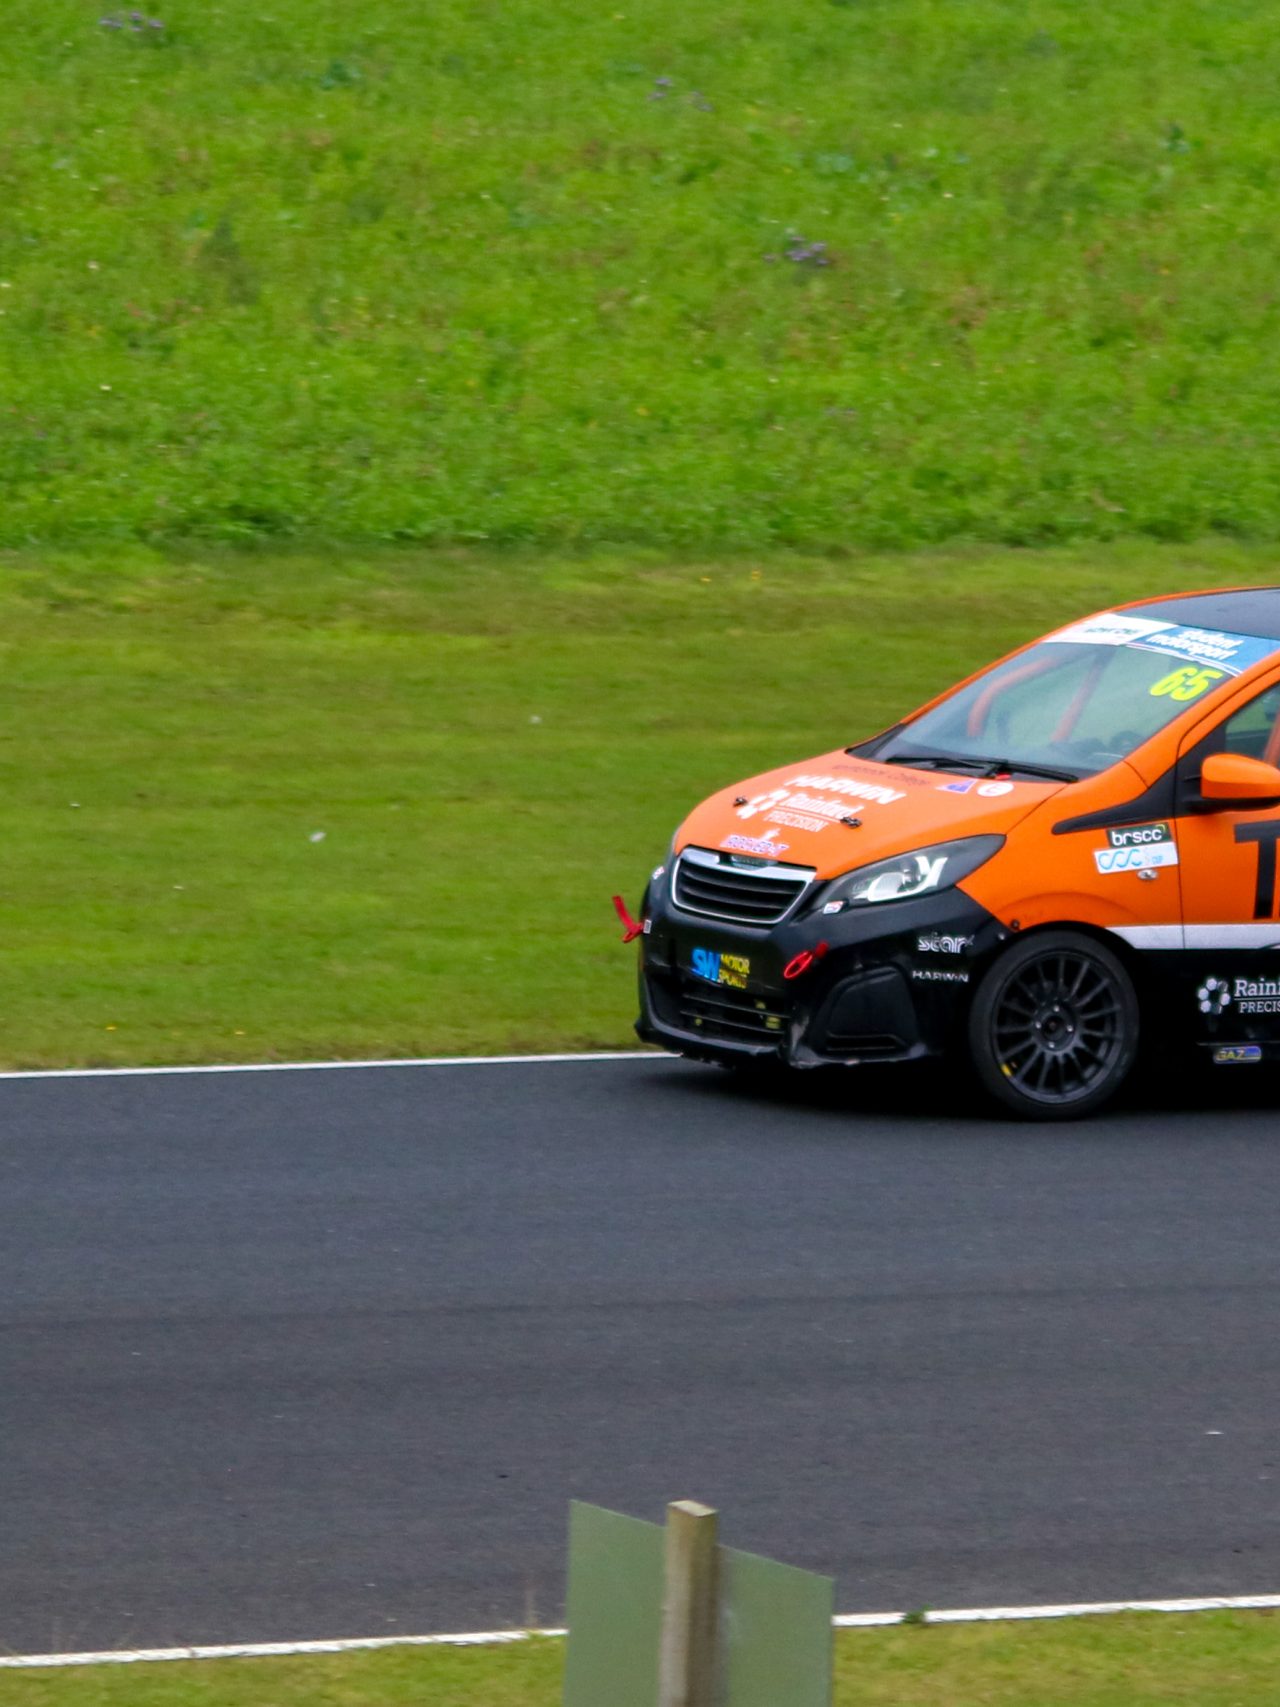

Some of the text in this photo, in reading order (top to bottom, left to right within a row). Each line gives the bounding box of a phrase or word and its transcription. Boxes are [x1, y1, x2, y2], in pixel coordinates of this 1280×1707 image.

[1149, 665, 1223, 701] 65
[764, 811, 829, 832] PRECISION
[1111, 828, 1163, 846] brscc
[917, 931, 967, 953] star
[720, 953, 750, 974] MOTOR
